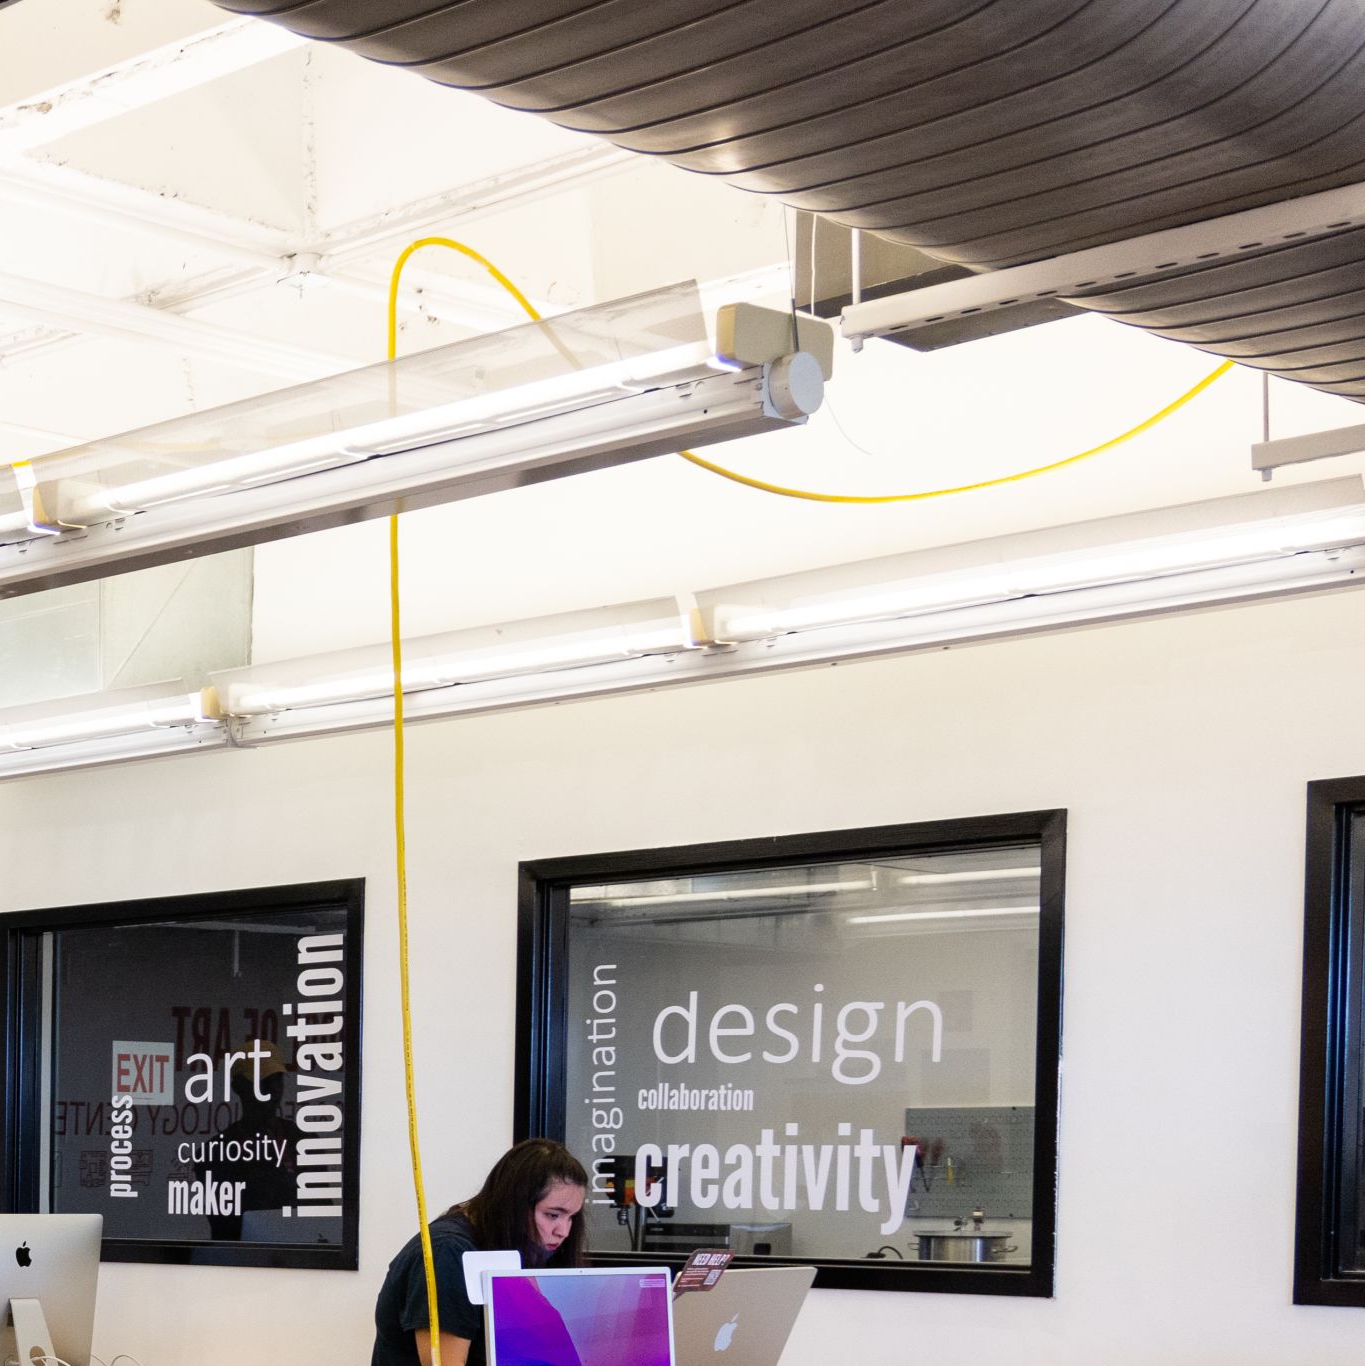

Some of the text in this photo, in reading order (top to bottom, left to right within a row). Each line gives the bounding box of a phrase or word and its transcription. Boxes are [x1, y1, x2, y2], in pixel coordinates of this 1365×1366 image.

[116, 1053, 170, 1094] EXIT
[183, 1039, 271, 1104] art
[282, 933, 344, 1217] innovation
[652, 983, 944, 1085] design
[584, 963, 623, 1205] imagination
[637, 1082, 754, 1111] collaboration
[109, 1094, 138, 1198] process
[177, 1132, 287, 1167] curiosity
[633, 1122, 918, 1236] creativity
[168, 1170, 246, 1216] maker
